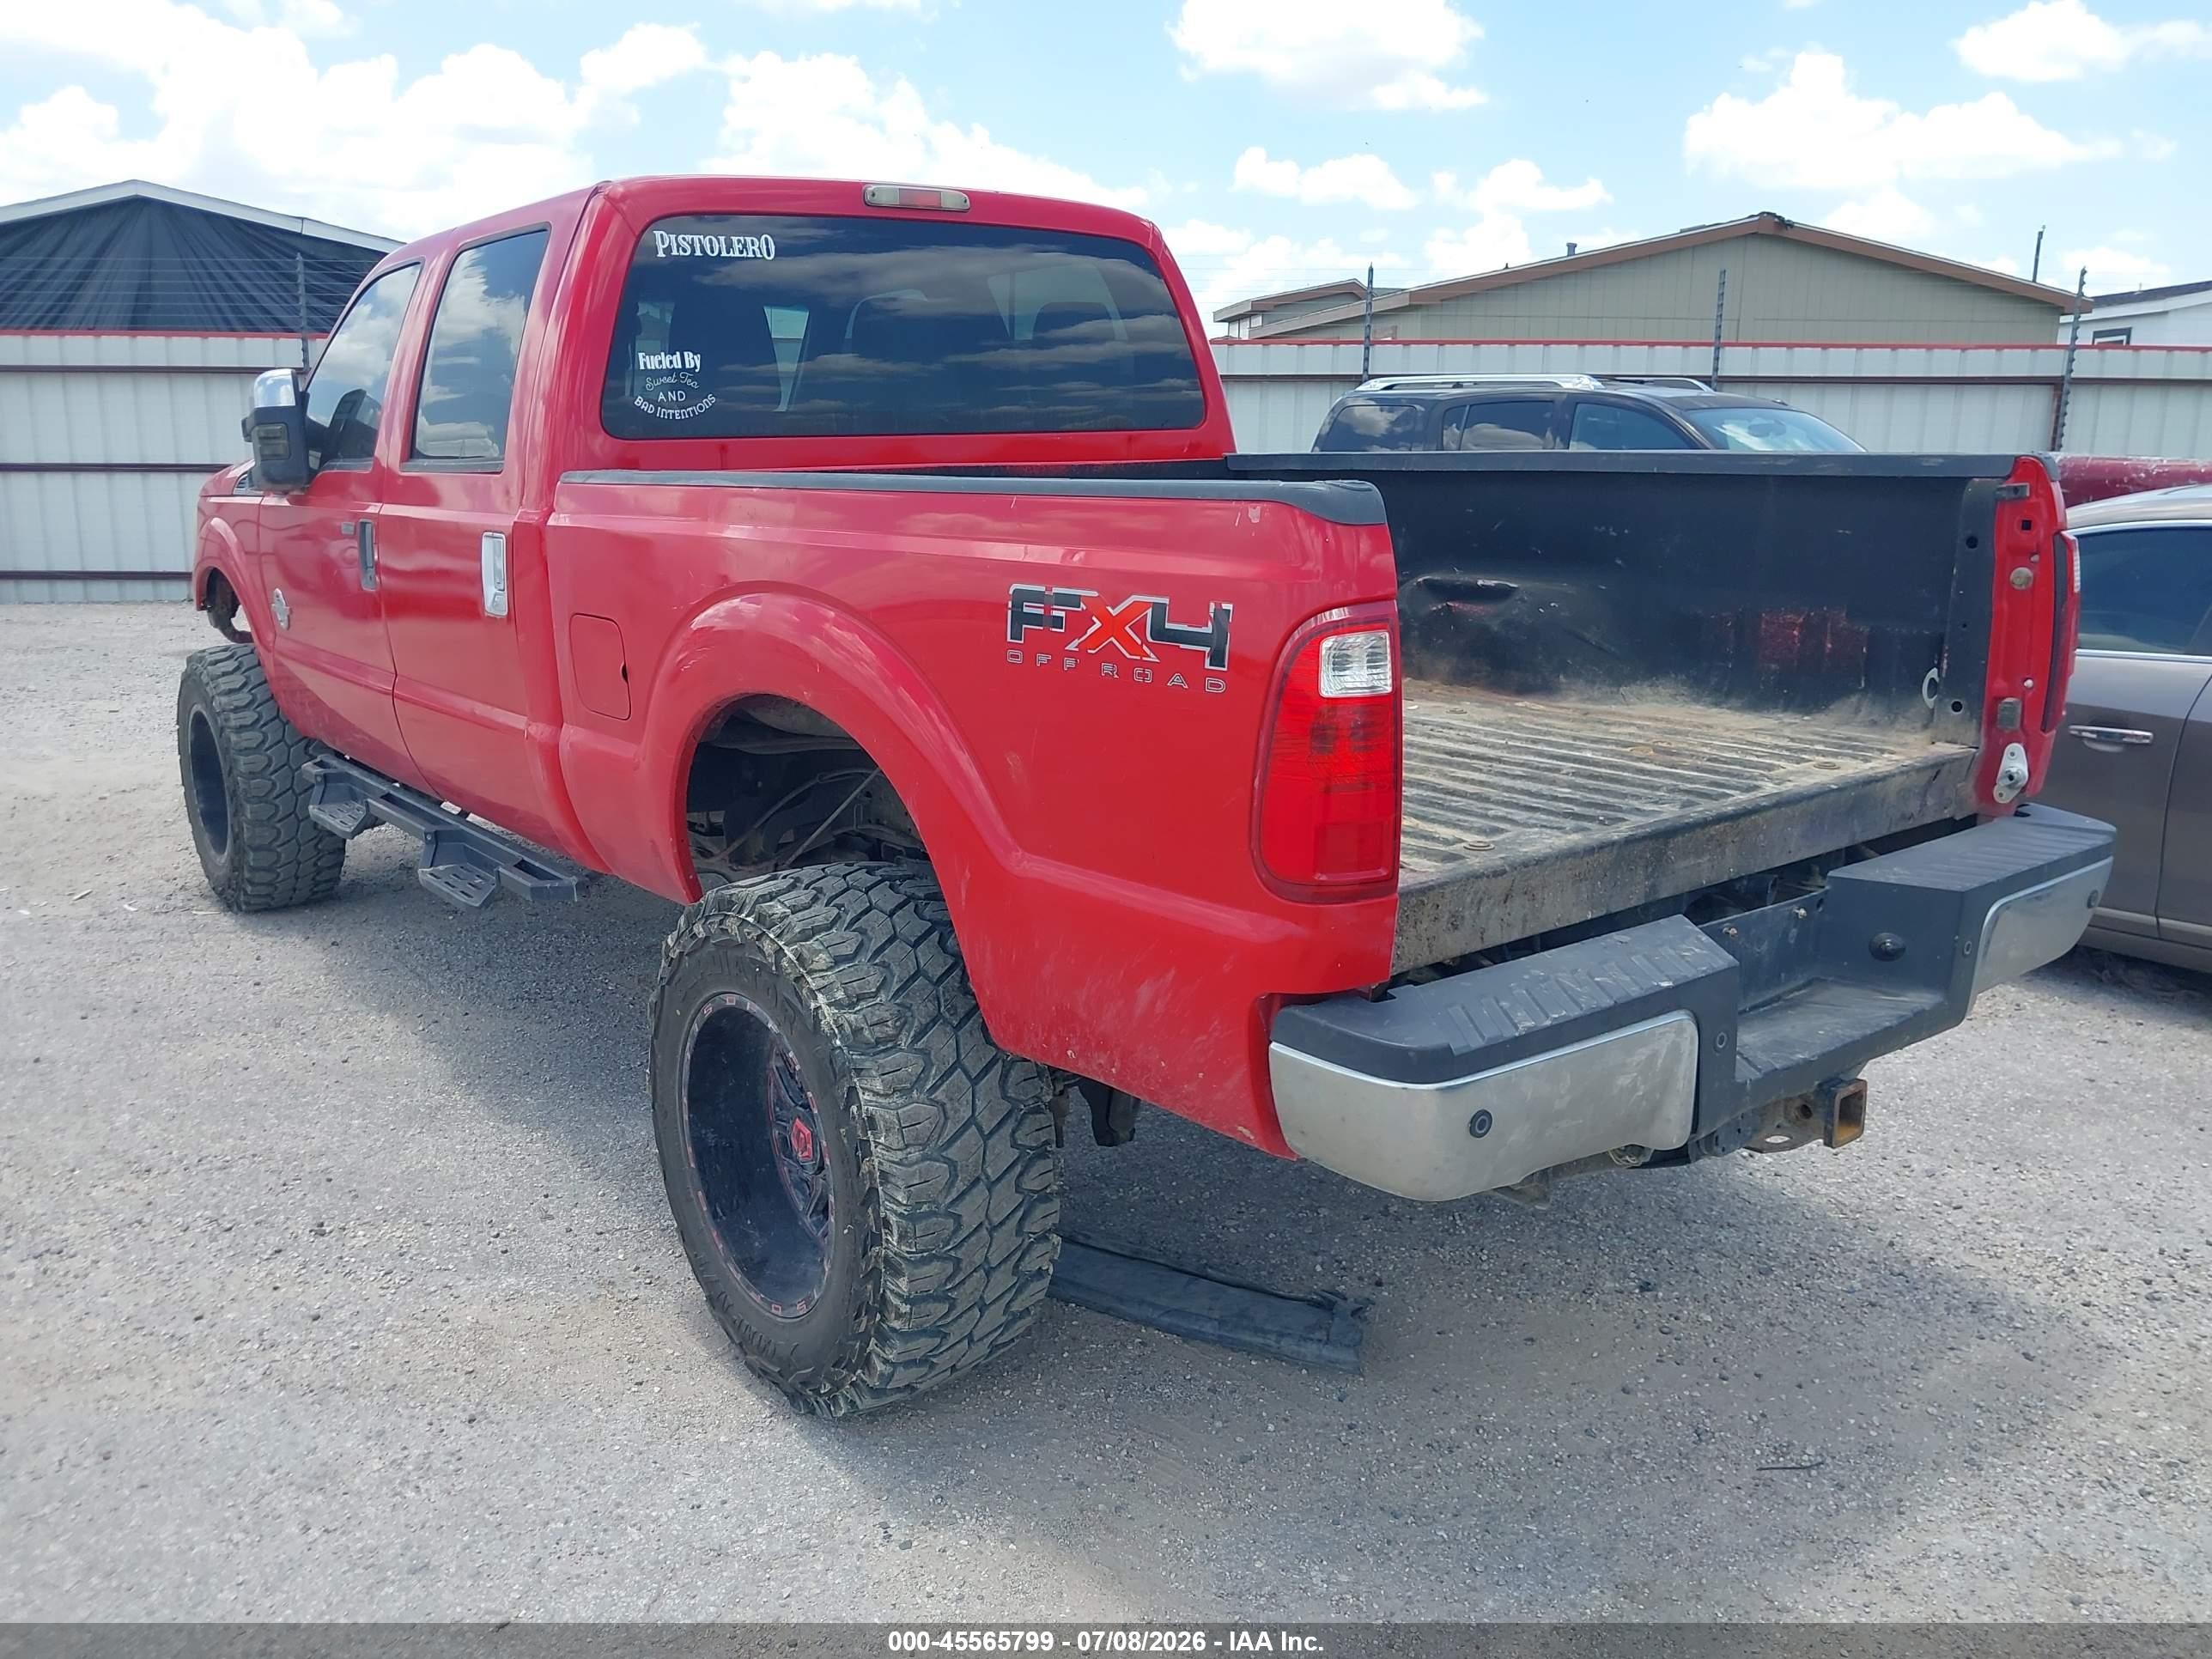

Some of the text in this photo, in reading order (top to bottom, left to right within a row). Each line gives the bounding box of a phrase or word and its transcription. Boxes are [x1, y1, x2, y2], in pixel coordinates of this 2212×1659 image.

[653, 230, 775, 260] PISTOLERO
[638, 351, 701, 373] Fueled By
[646, 372, 700, 391] Sweet Tea
[634, 393, 716, 420] BAD INTENTIONS
[658, 391, 686, 403] AND
[1007, 584, 1233, 671] FX4
